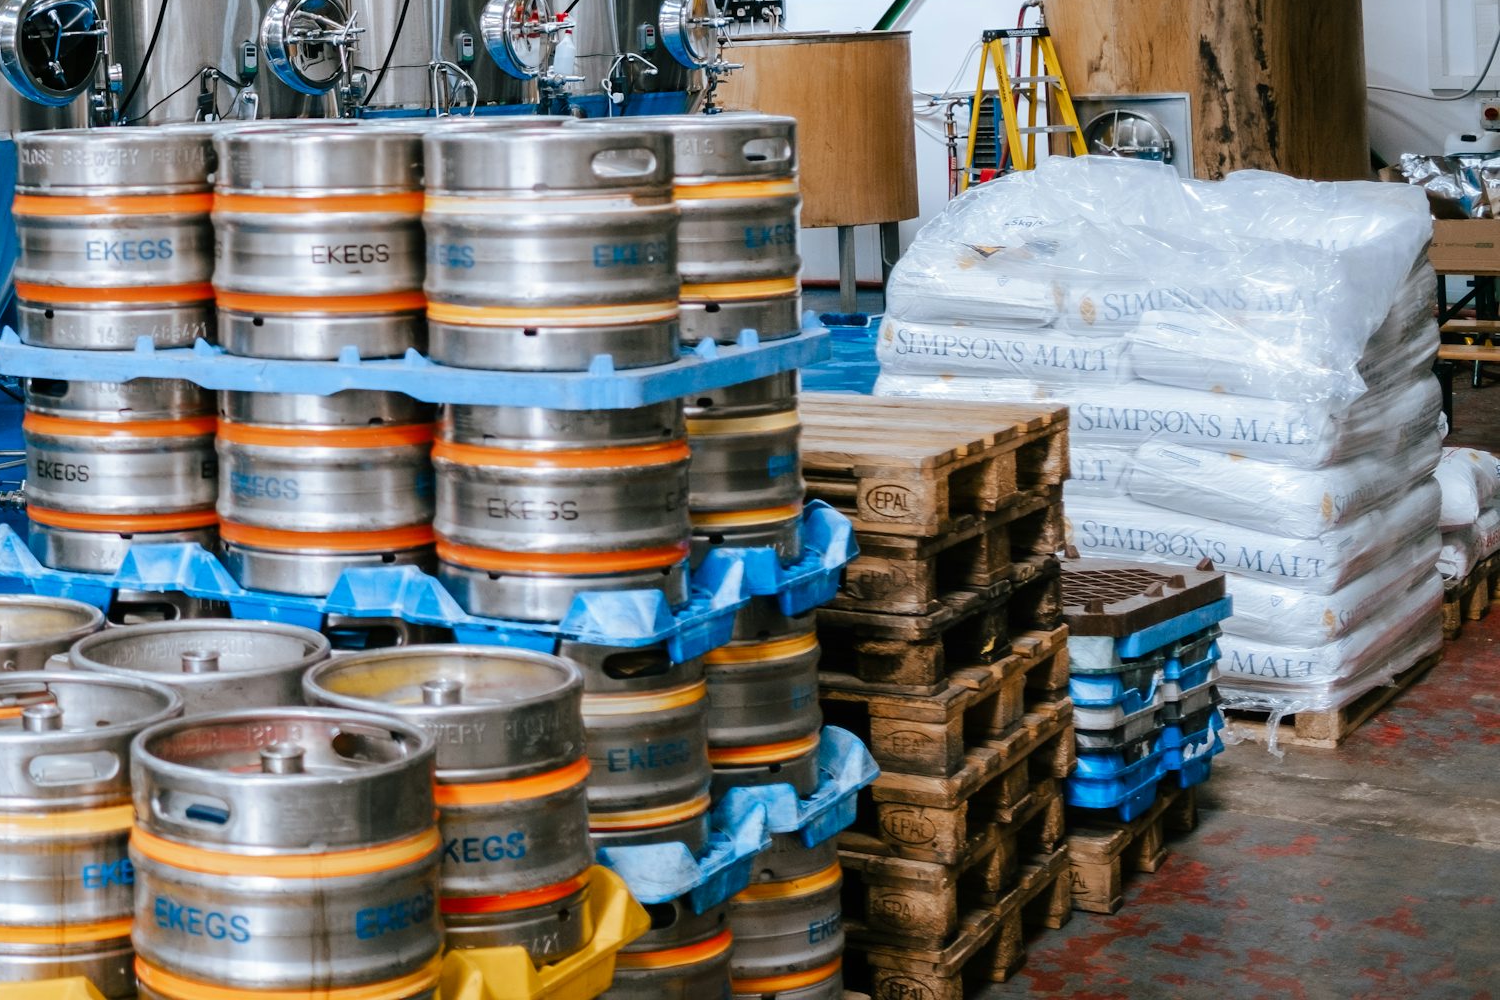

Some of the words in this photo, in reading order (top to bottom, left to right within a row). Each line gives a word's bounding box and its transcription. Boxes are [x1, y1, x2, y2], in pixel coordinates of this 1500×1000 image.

[86, 238, 174, 262] EKEGS
[311, 243, 391, 265] EKEGS
[1104, 287, 1248, 322] SIMPSONS
[896, 328, 1025, 363] SIMPSONS
[1033, 343, 1112, 372] MALT
[1077, 402, 1221, 438] SIMPSONS
[37, 459, 90, 482] EKEGS
[487, 498, 579, 521] EKEGS
[875, 491, 910, 512] EPAL
[1082, 520, 1226, 565] SIMPSONS
[1237, 546, 1325, 578] MALT
[1229, 650, 1319, 678] MALT
[443, 831, 526, 864] KEGS
[154, 896, 251, 944] EKEGS
